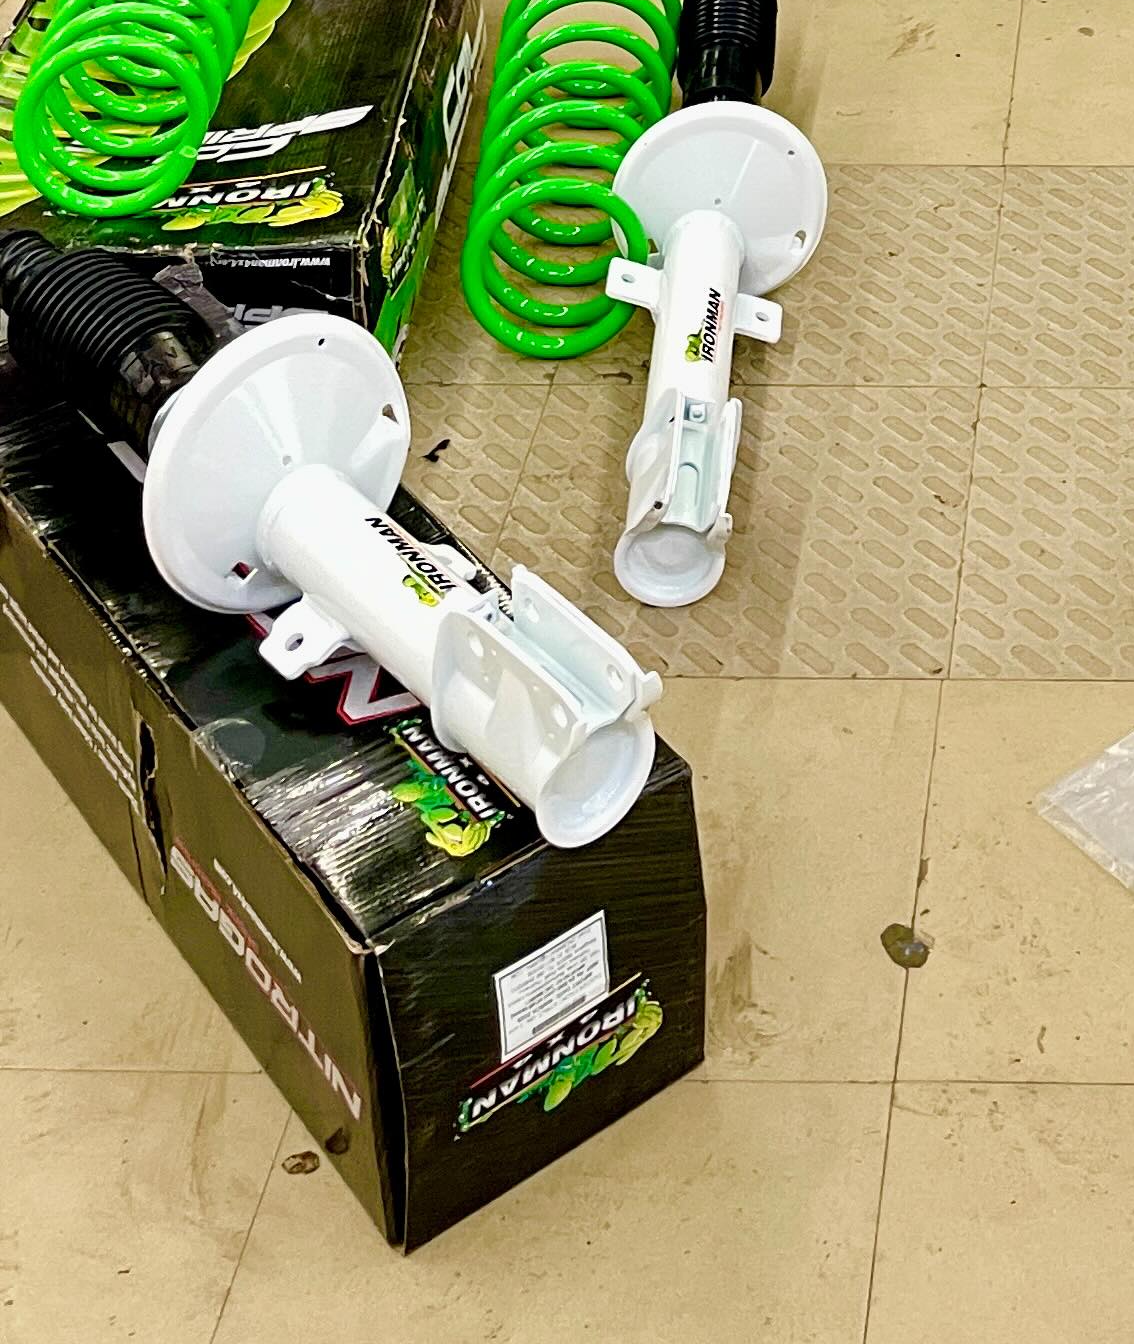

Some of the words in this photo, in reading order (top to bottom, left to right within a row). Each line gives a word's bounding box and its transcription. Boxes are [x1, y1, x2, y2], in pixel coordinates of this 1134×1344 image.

[701, 288, 722, 363] IRONMAN
[365, 516, 459, 590] IRONMAN
[402, 725, 498, 820] IRONMAN
[169, 843, 361, 1121] NITROGAS
[472, 996, 635, 1119] IRONMAN
